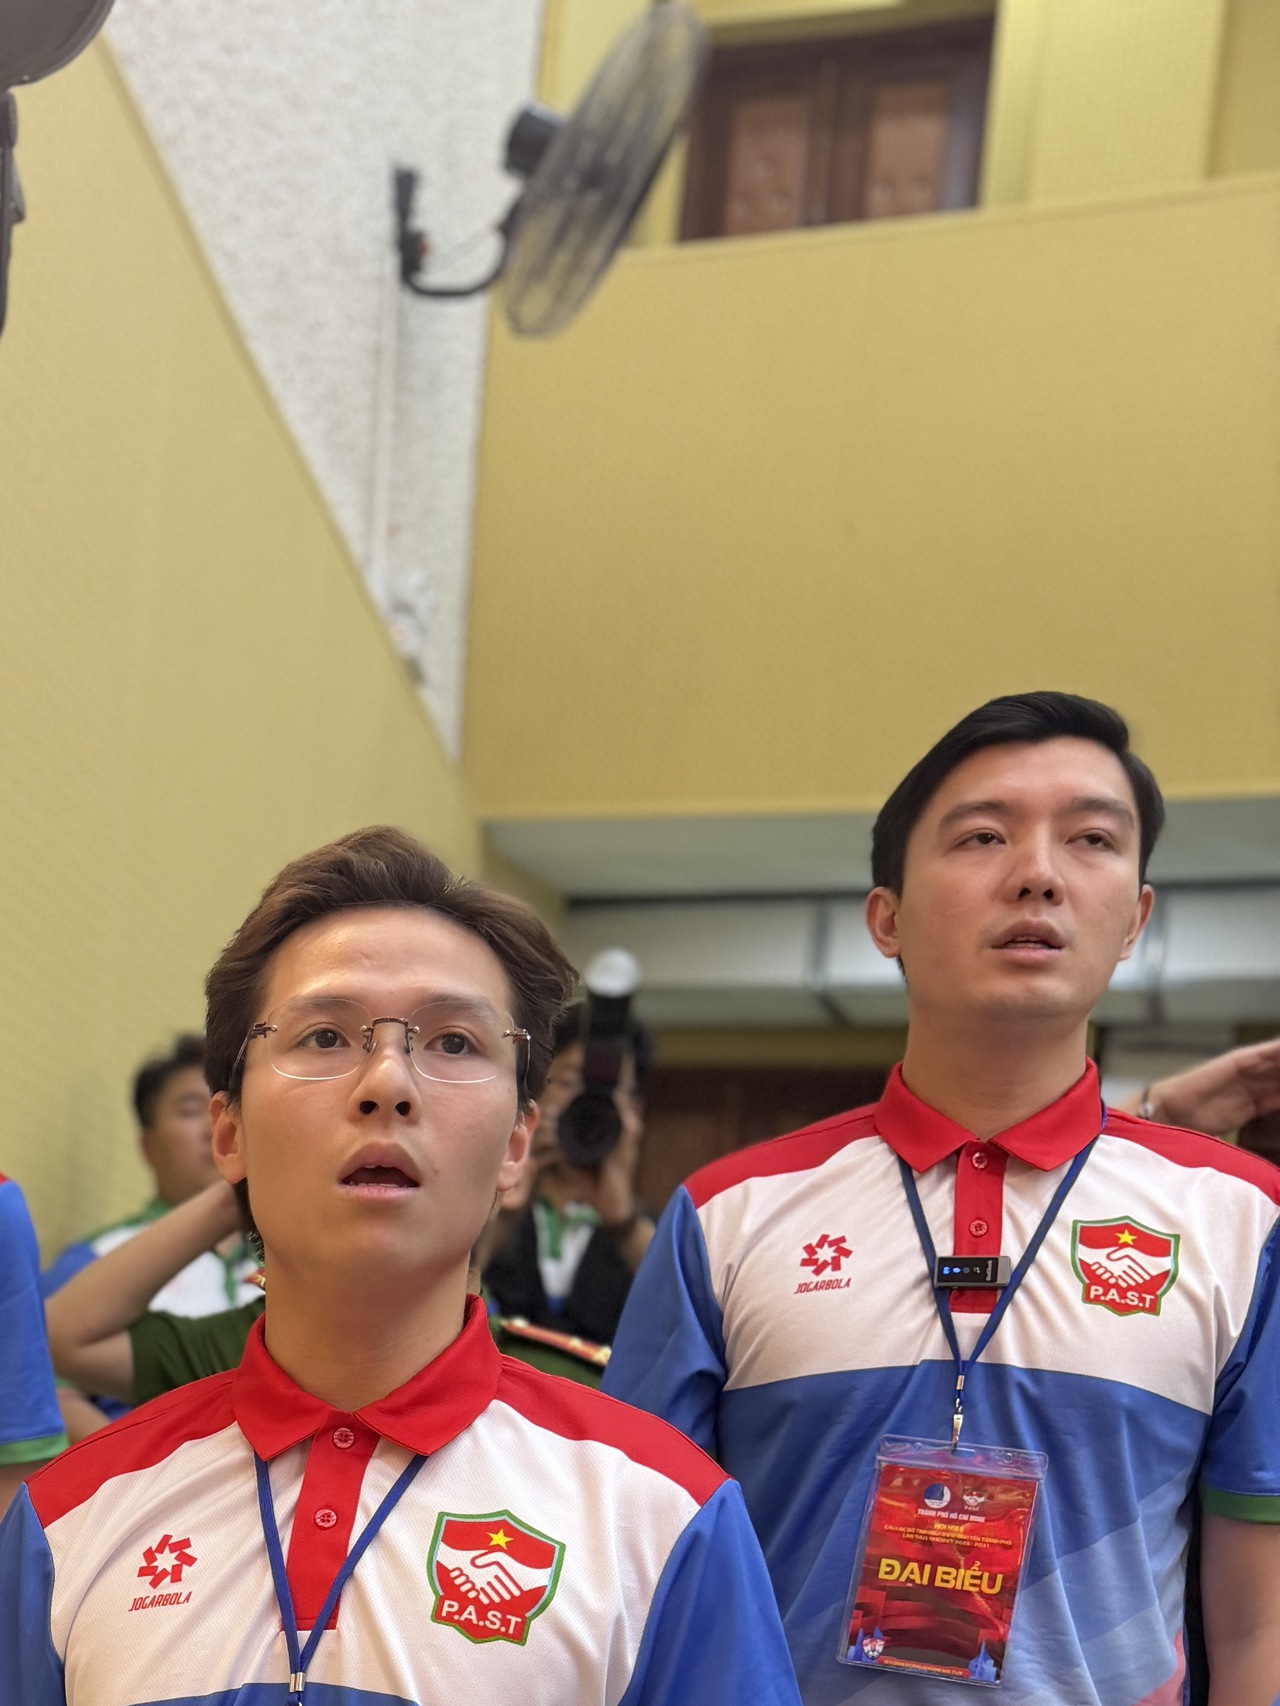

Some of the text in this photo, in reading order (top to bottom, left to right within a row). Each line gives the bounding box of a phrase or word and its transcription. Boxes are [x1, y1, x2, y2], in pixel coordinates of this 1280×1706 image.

[794, 1277, 852, 1295] JOGARBOLA
[1090, 1285, 1154, 1309] P.A.S.T
[878, 1558, 1003, 1595] ĐẠI BIỂU
[128, 1591, 193, 1613] JOGARBOLA
[442, 1600, 521, 1635] P.A.S.T
